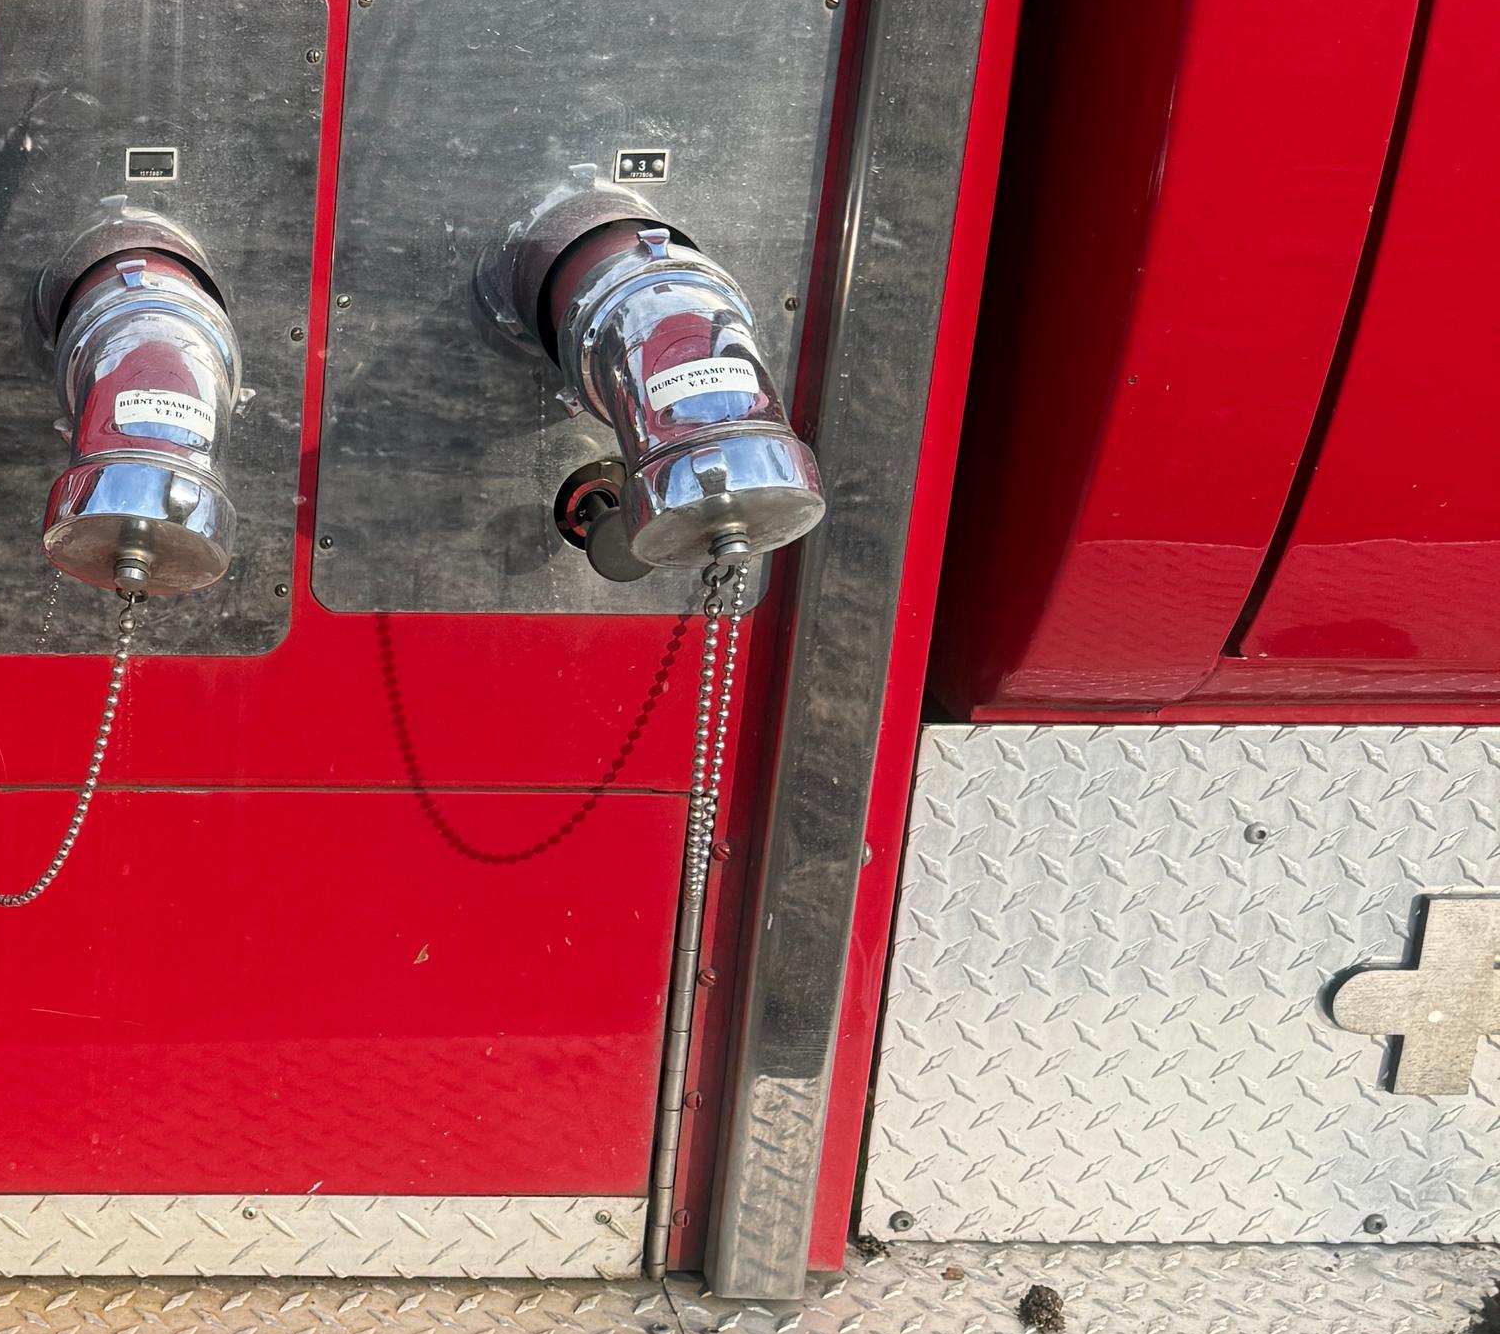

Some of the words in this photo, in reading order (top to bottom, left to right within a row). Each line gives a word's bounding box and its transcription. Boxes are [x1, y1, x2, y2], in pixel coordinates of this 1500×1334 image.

[638, 159, 646, 172] 3
[650, 374, 685, 394] BURNT
[688, 367, 726, 379] SWAMP
[119, 398, 154, 408] BURNT
[157, 399, 192, 411] SWAMP
